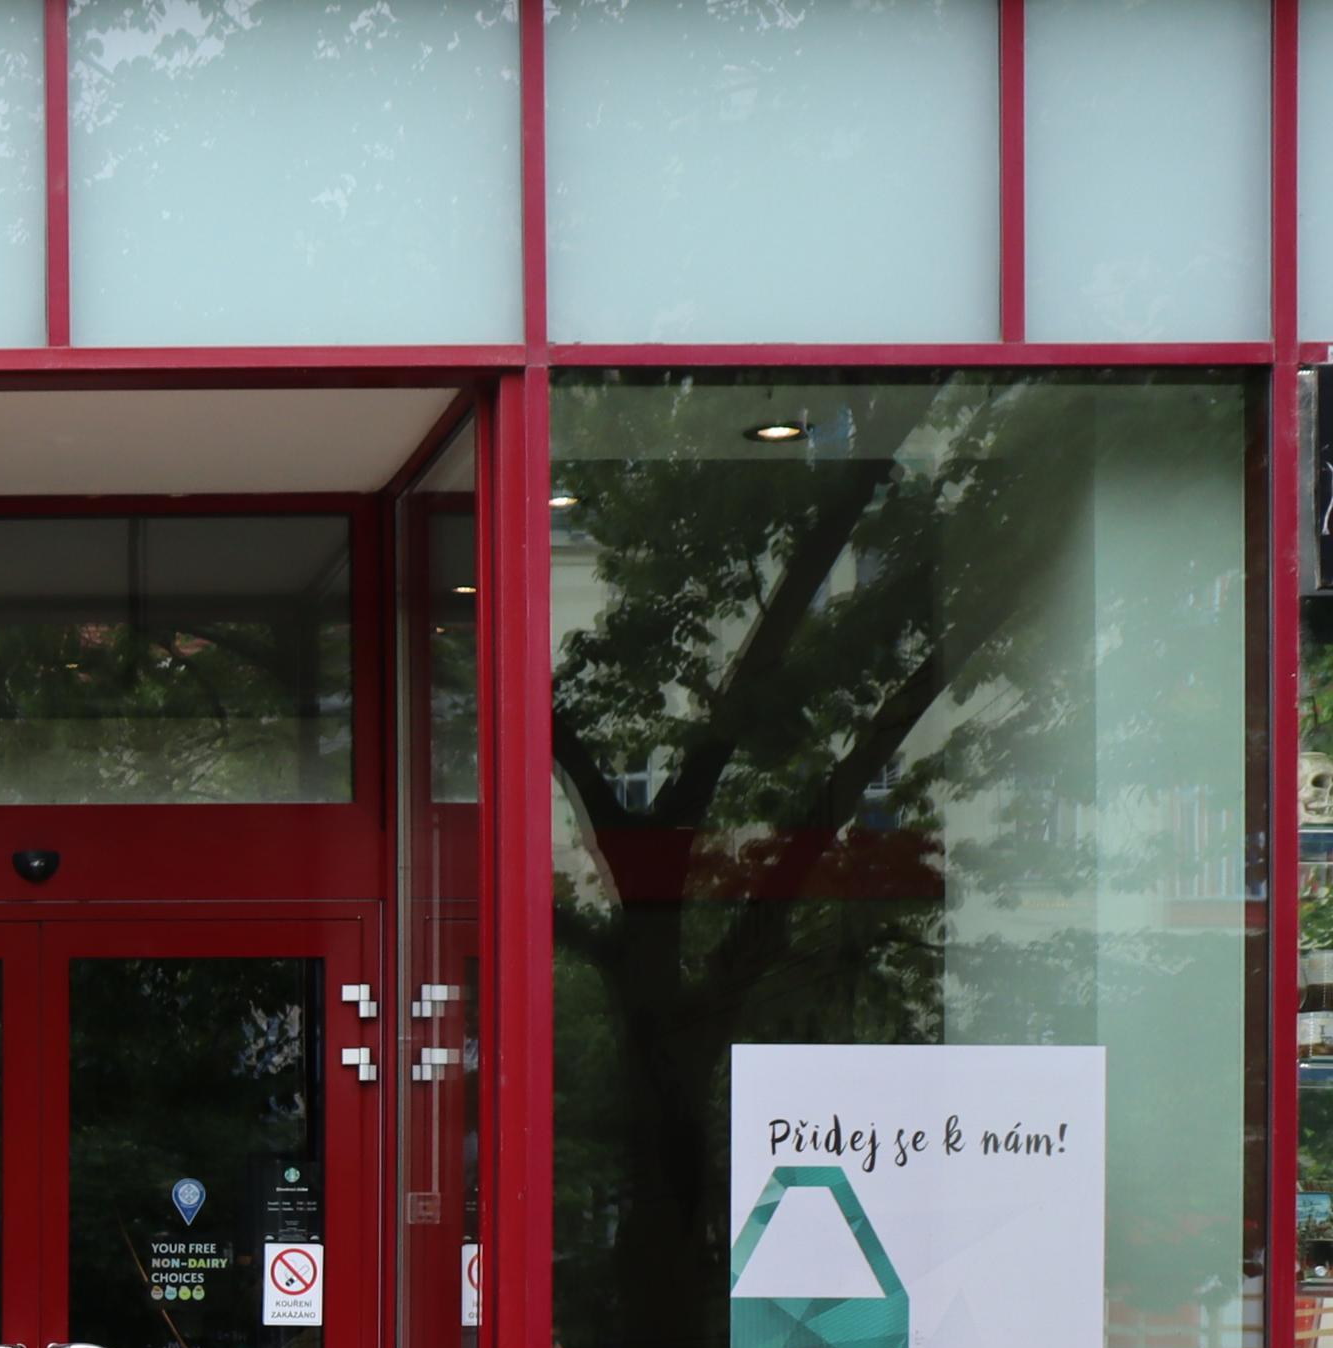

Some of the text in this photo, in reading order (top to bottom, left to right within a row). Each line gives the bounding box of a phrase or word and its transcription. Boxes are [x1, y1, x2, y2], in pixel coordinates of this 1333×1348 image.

[768, 1114, 1068, 1173] Přidej se k nám!
[152, 1243, 217, 1254] YOUR FREE
[151, 1258, 228, 1268] NON-DAIRY
[151, 1273, 205, 1283] CHOICES
[275, 1299, 312, 1307] KOUŘENÍ
[271, 1310, 316, 1318] ZAKÁZÁNO
